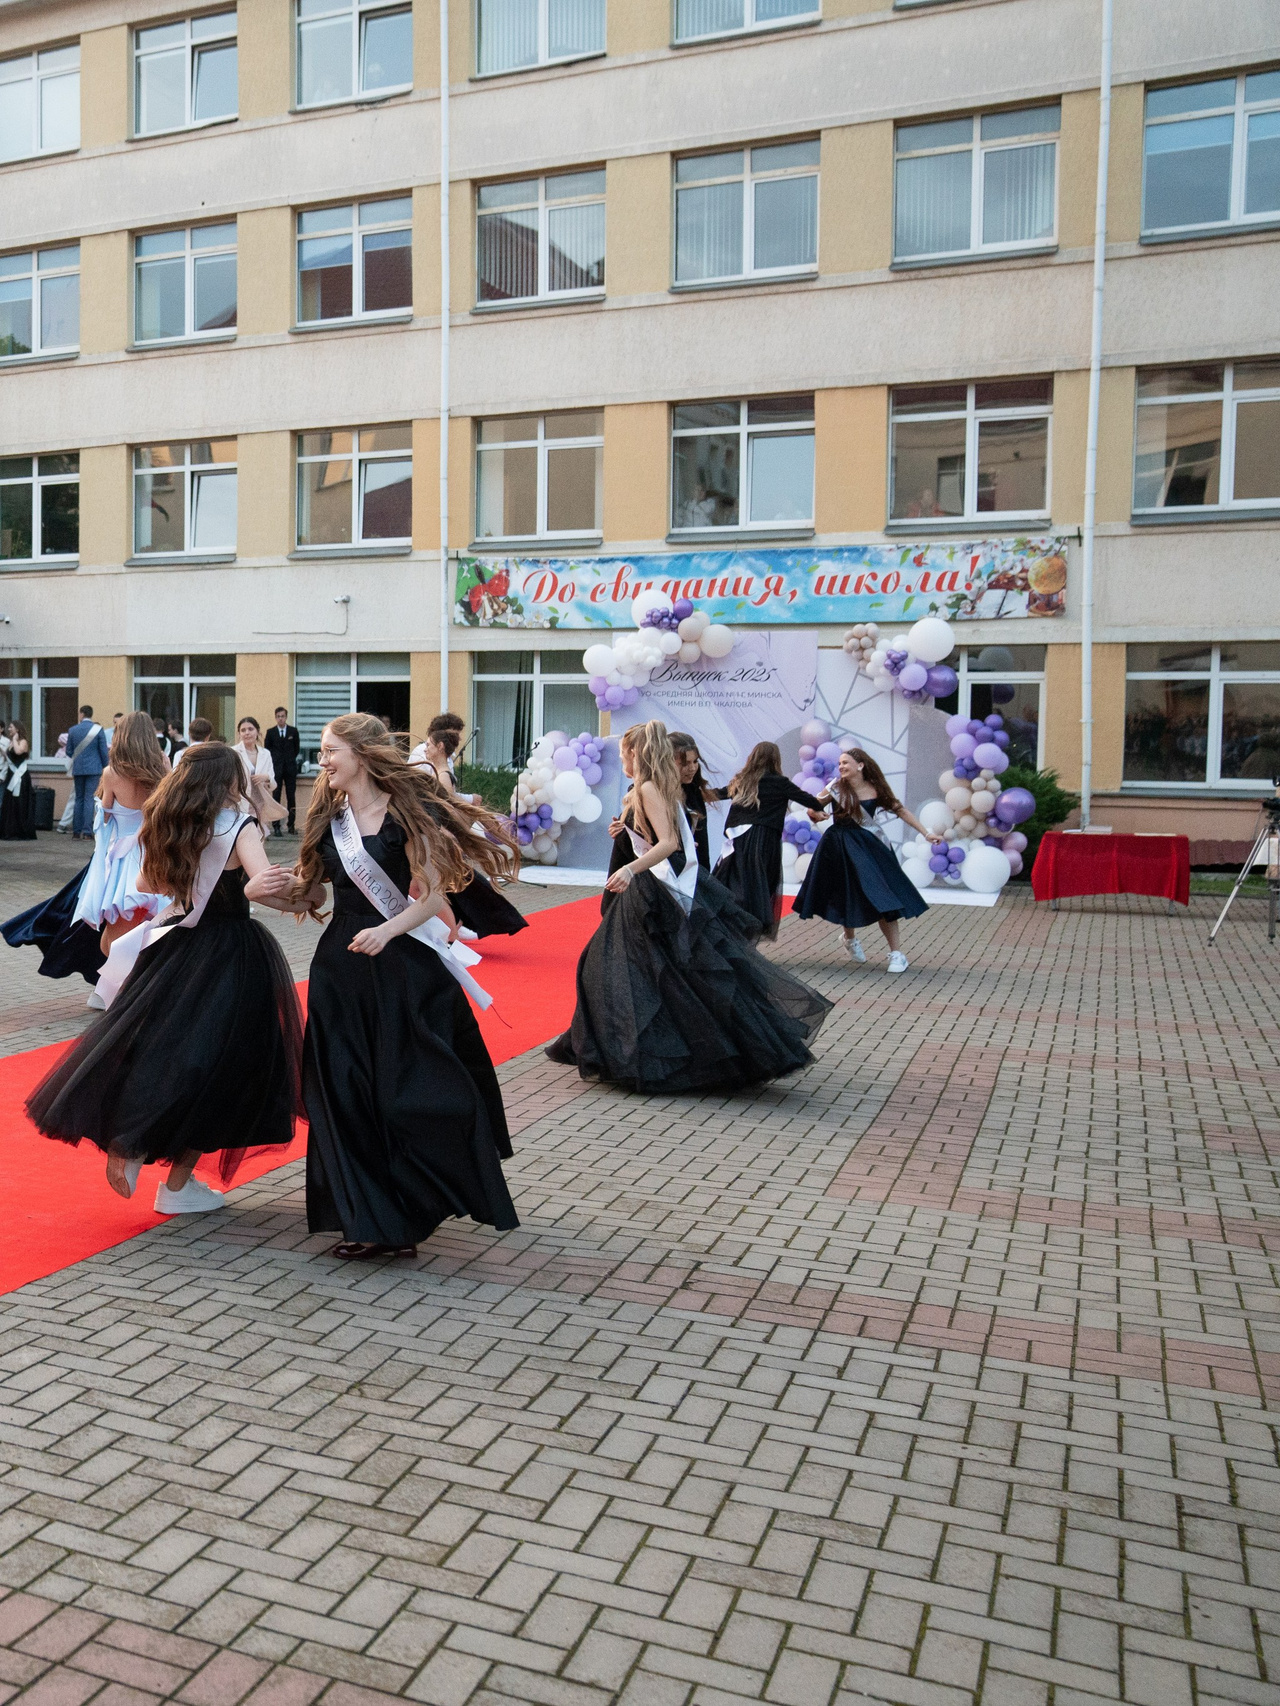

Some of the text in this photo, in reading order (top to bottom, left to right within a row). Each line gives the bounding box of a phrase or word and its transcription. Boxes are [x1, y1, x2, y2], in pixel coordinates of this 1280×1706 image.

[523, 569, 577, 603] До
[813, 555, 981, 596] школа!
[650, 659, 778, 691] Выпуск 2025
[694, 690, 725, 698] ШКОЛА
[747, 691, 783, 699] МИНСКА
[714, 701, 753, 709] ЧКАЛОВА
[379, 889, 405, 917] 202
